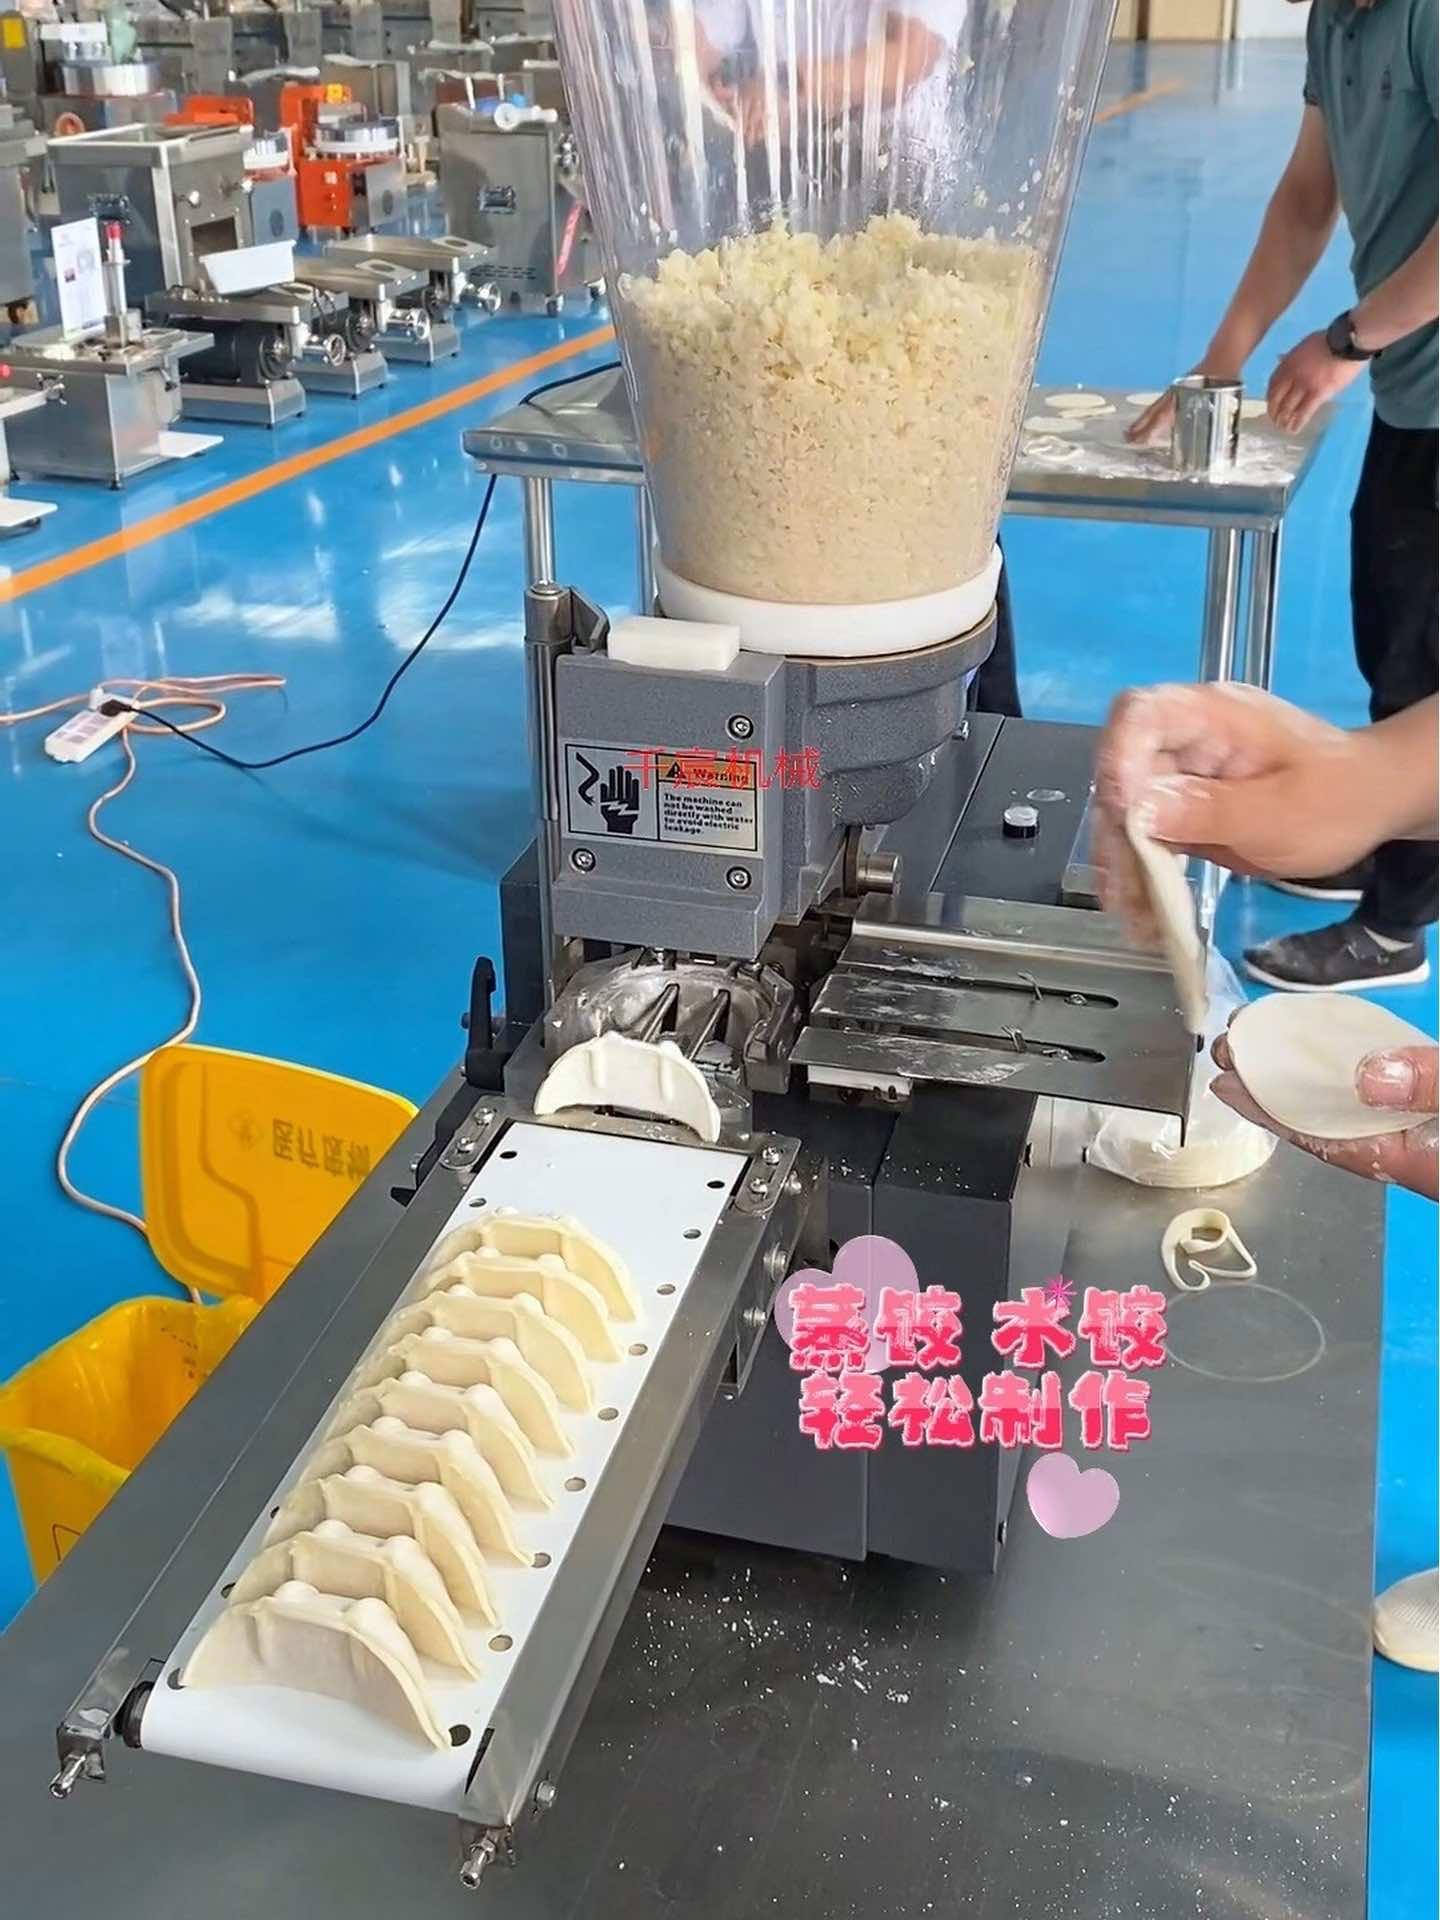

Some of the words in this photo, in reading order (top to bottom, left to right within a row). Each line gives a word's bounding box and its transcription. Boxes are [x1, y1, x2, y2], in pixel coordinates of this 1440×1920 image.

[693, 768, 749, 785] Warning
[663, 793, 682, 802] The
[683, 795, 724, 806] machine
[725, 799, 742, 807] can
[681, 802, 694, 810] be
[695, 805, 733, 814] washed
[663, 809, 700, 820] directly
[702, 812, 724, 821] with
[676, 818, 703, 826] avoid
[704, 820, 740, 830] electric
